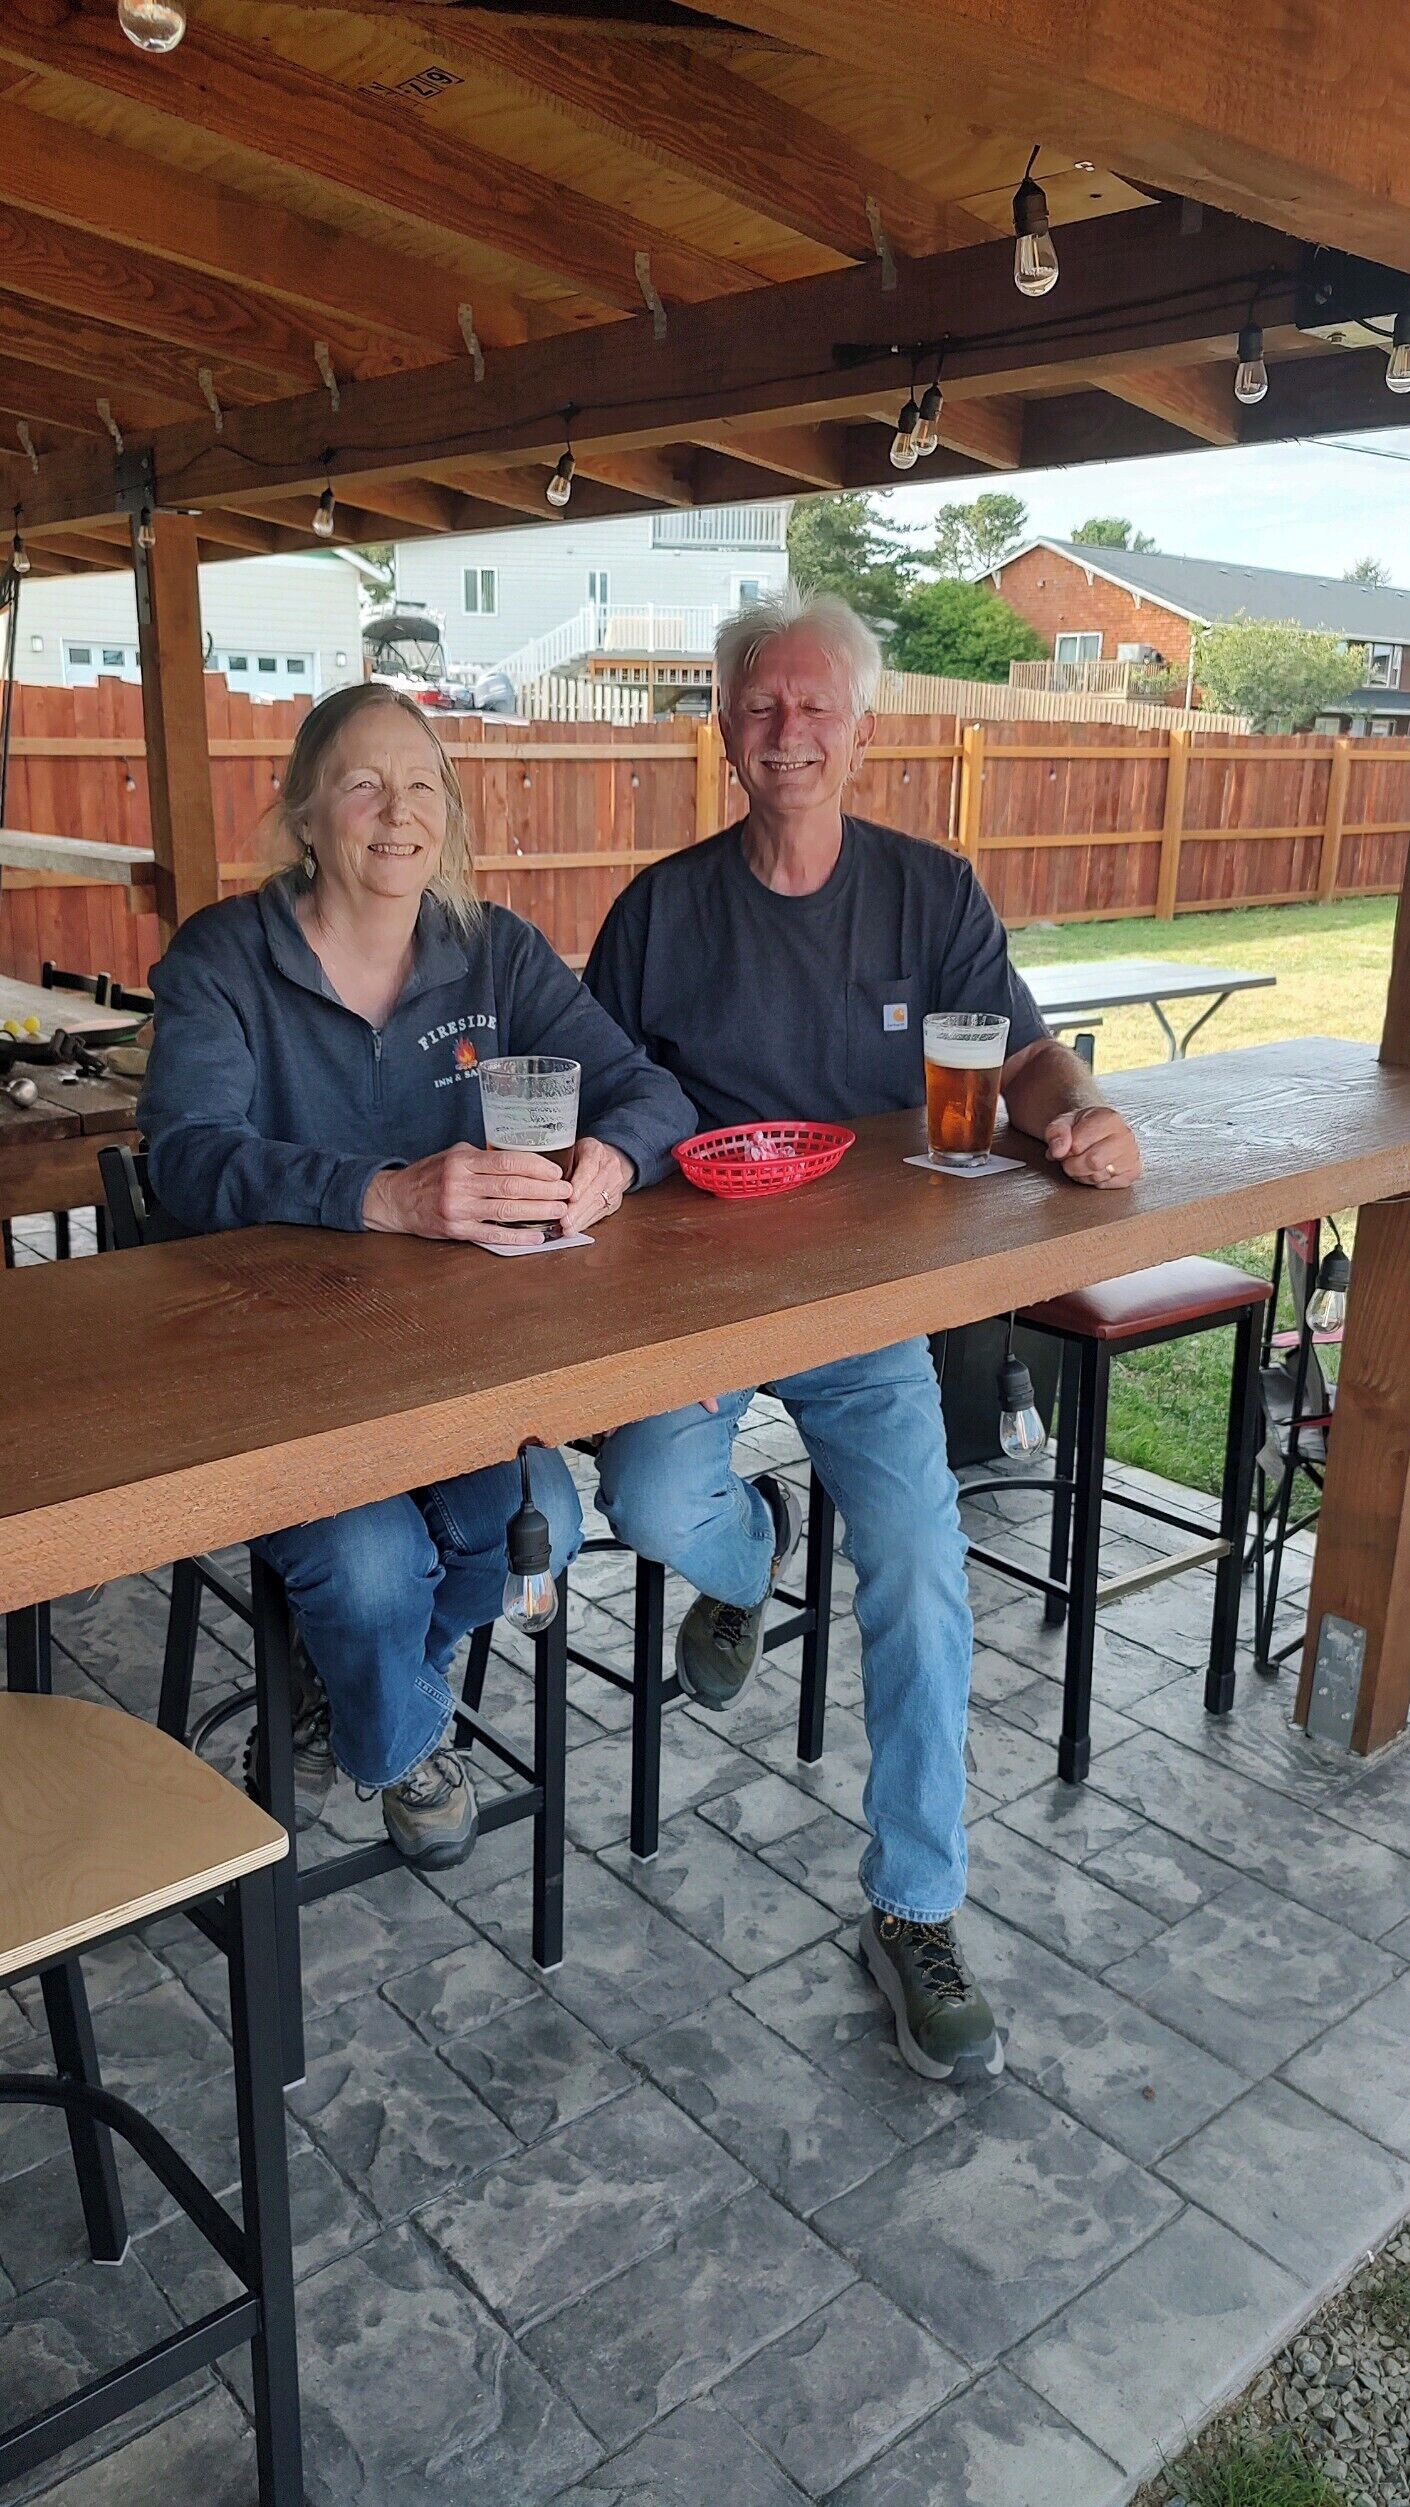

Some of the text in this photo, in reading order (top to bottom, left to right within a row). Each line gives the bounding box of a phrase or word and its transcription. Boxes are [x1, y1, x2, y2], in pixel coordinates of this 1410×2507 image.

[417, 1014, 497, 1051] FIRESIDE
[434, 1076, 453, 1088] INN
[455, 1073, 462, 1081] &
